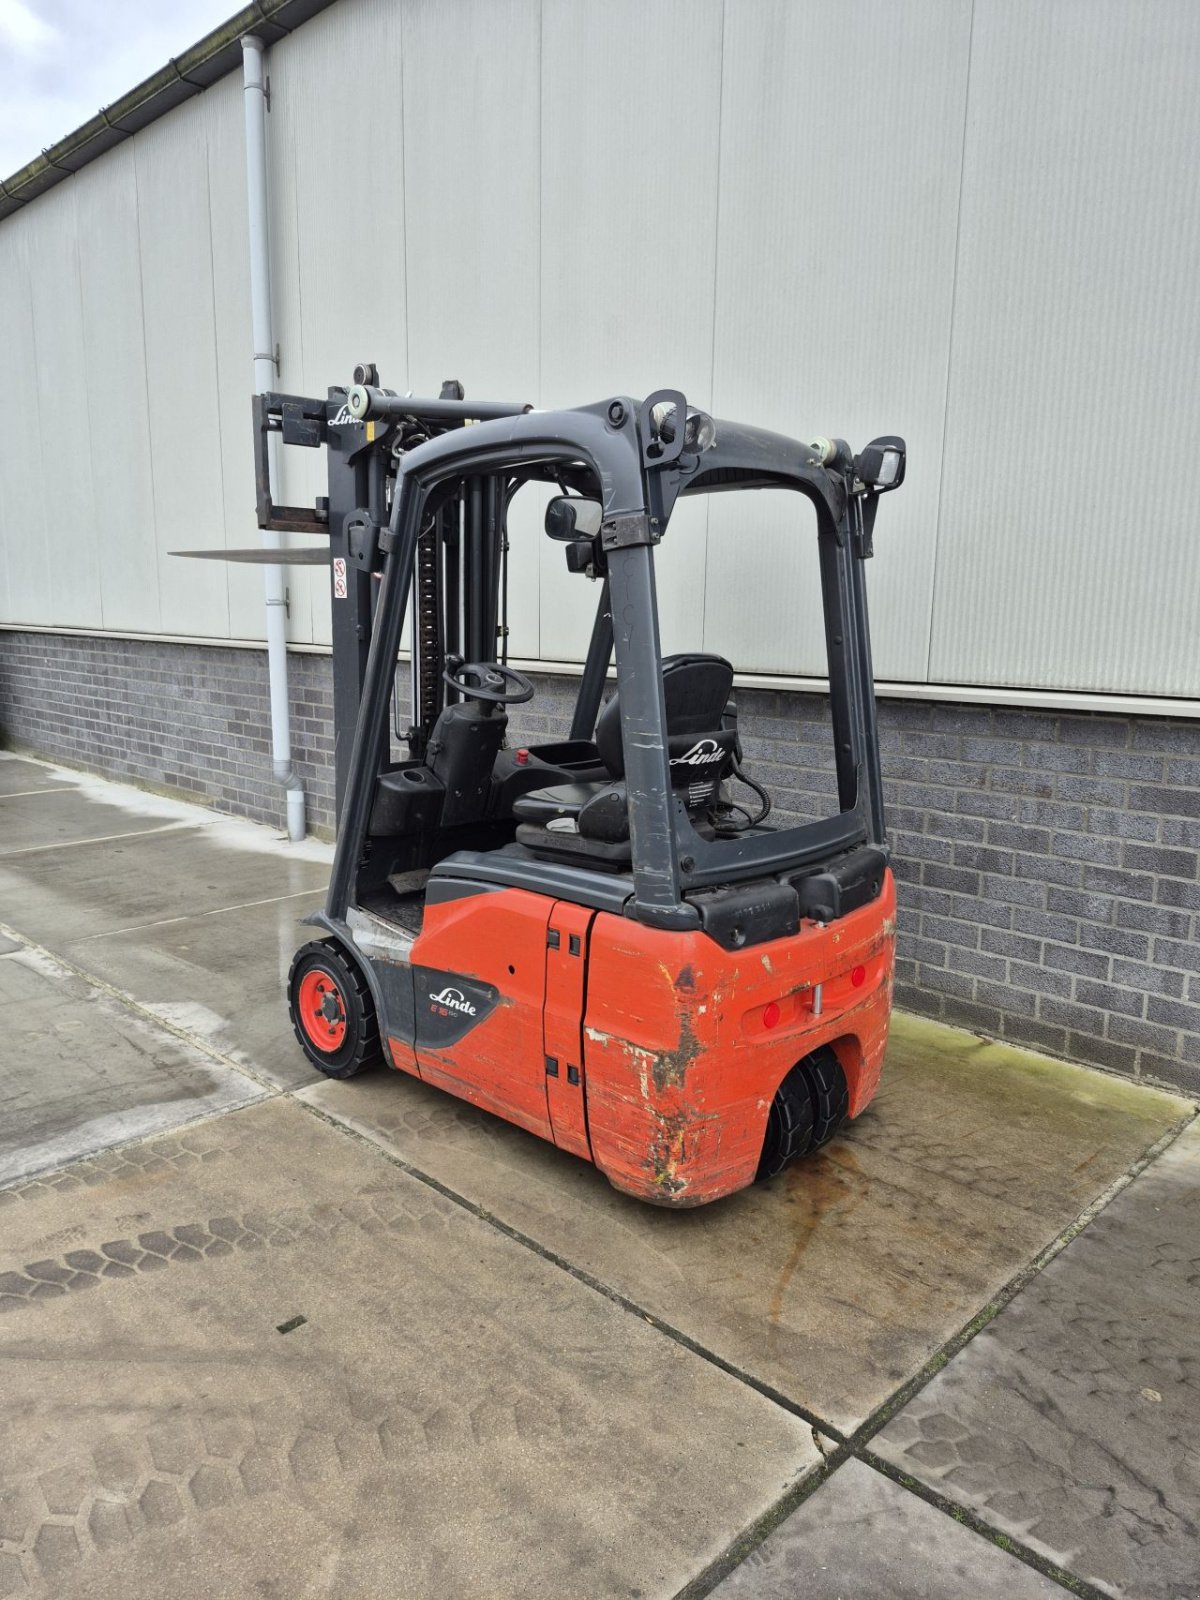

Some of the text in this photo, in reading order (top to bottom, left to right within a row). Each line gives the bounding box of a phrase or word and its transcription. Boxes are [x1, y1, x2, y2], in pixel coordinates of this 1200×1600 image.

[328, 404, 364, 426] Lin
[669, 739, 726, 766] Linde
[429, 987, 477, 1016] Linde
